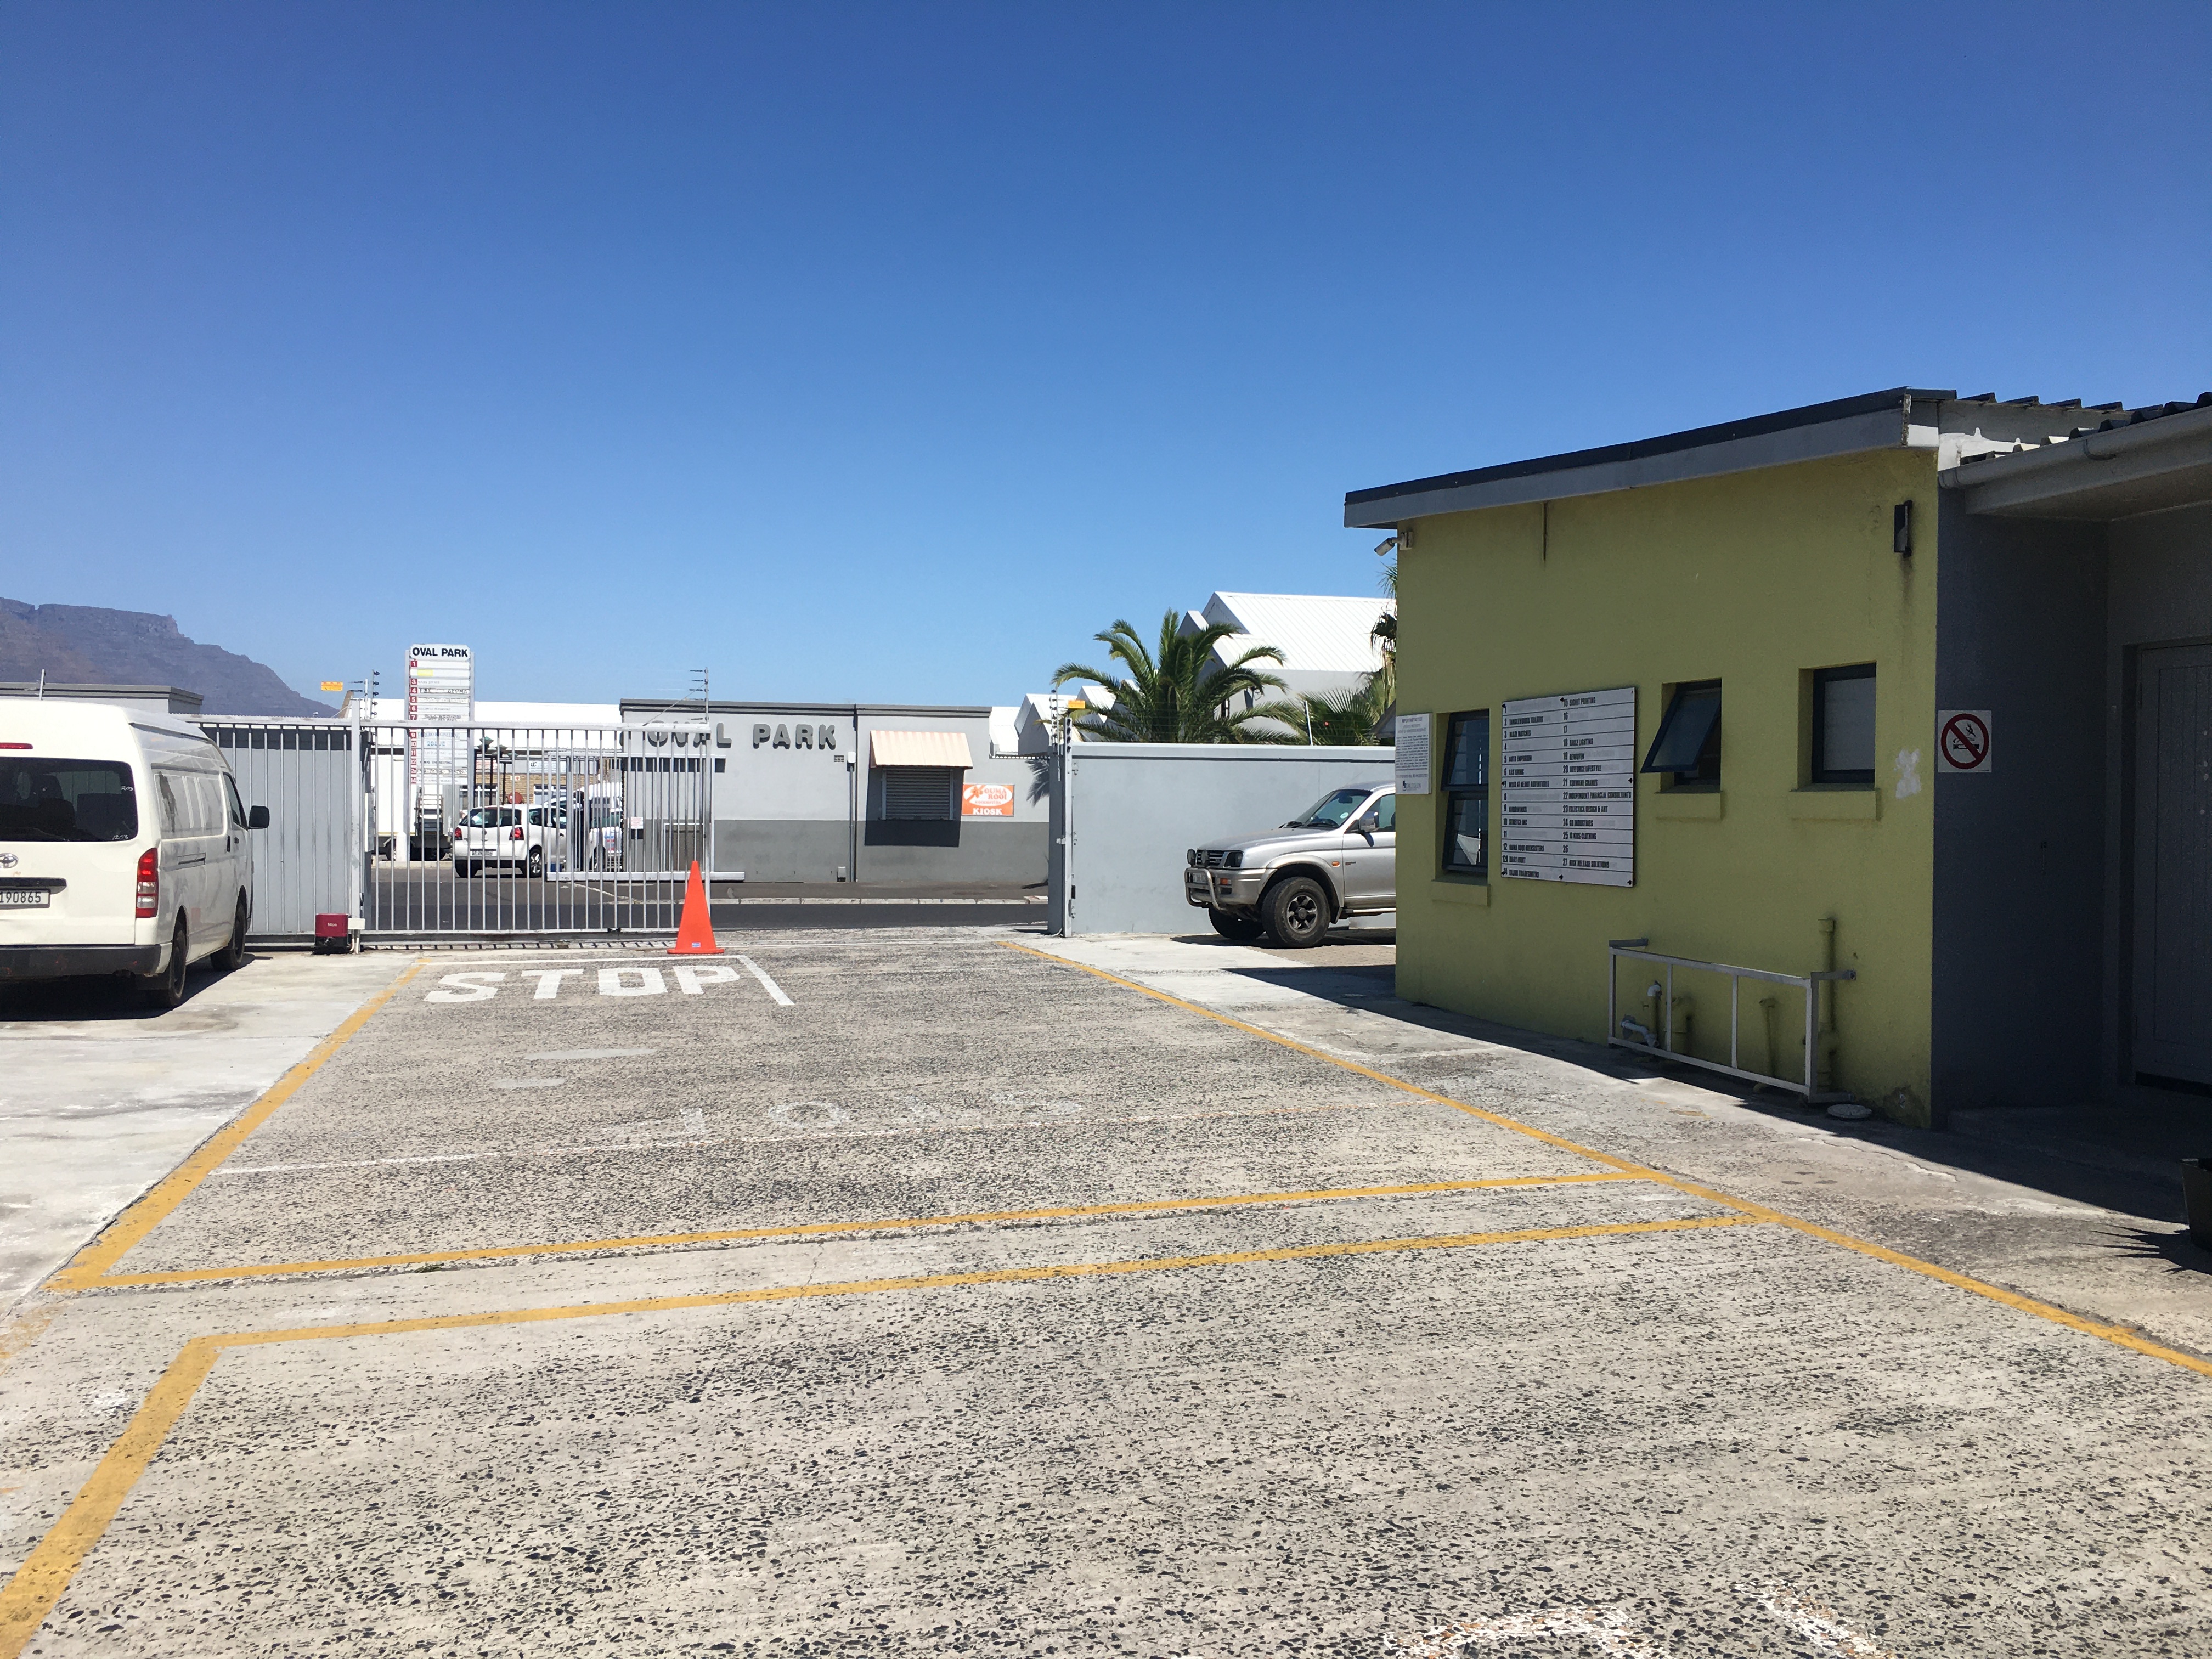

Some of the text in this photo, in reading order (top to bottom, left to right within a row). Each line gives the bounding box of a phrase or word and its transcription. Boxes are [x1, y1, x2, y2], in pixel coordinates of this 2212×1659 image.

[413, 647, 468, 657] OVAL PARK
[753, 723, 837, 750] PARK
[1563, 831, 1568, 839] 25
[0, 891, 41, 903] 190865
[424, 964, 741, 1003] STOP
